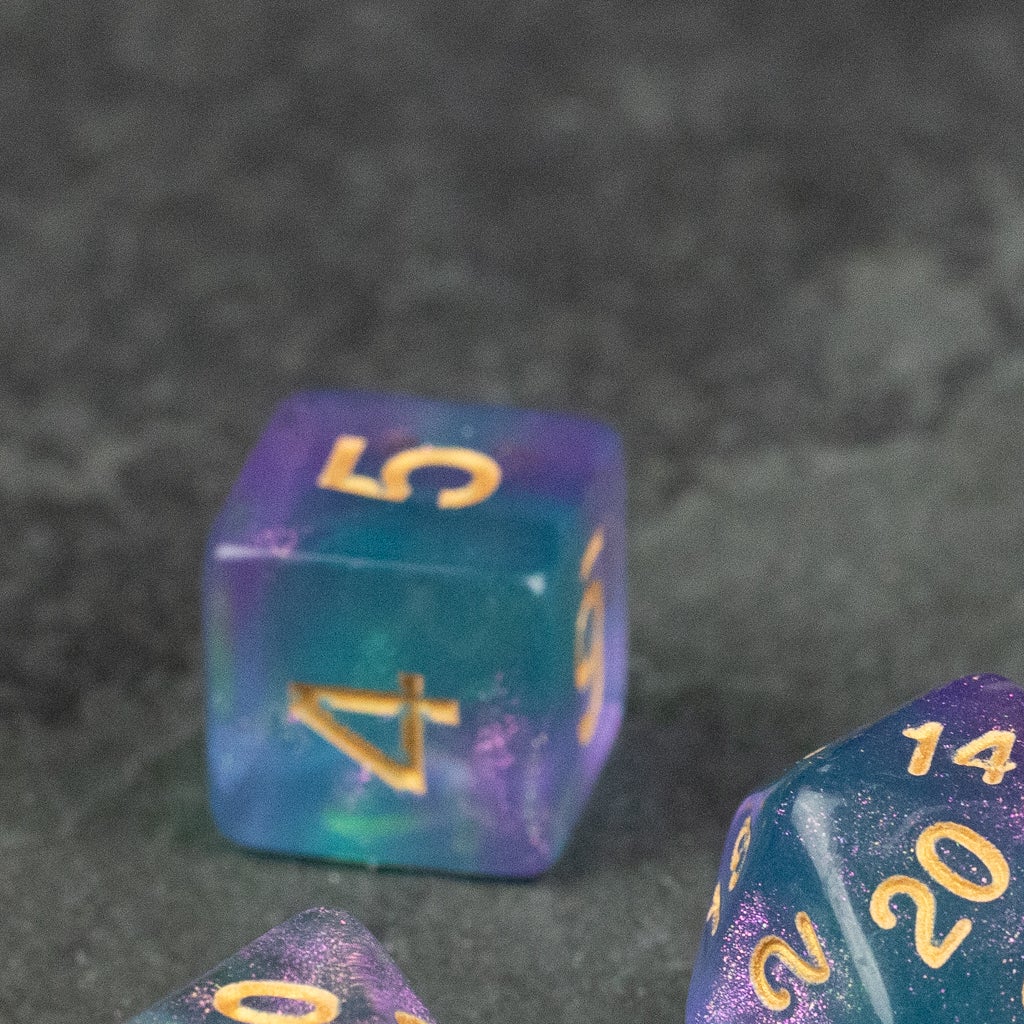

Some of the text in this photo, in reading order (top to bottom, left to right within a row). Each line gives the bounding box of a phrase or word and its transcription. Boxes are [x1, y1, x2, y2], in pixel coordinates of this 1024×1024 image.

[317, 434, 502, 509] 5
[286, 672, 461, 795] 4
[902, 721, 1017, 785] 14
[870, 821, 1011, 969] 20
[749, 911, 830, 1012] 2
